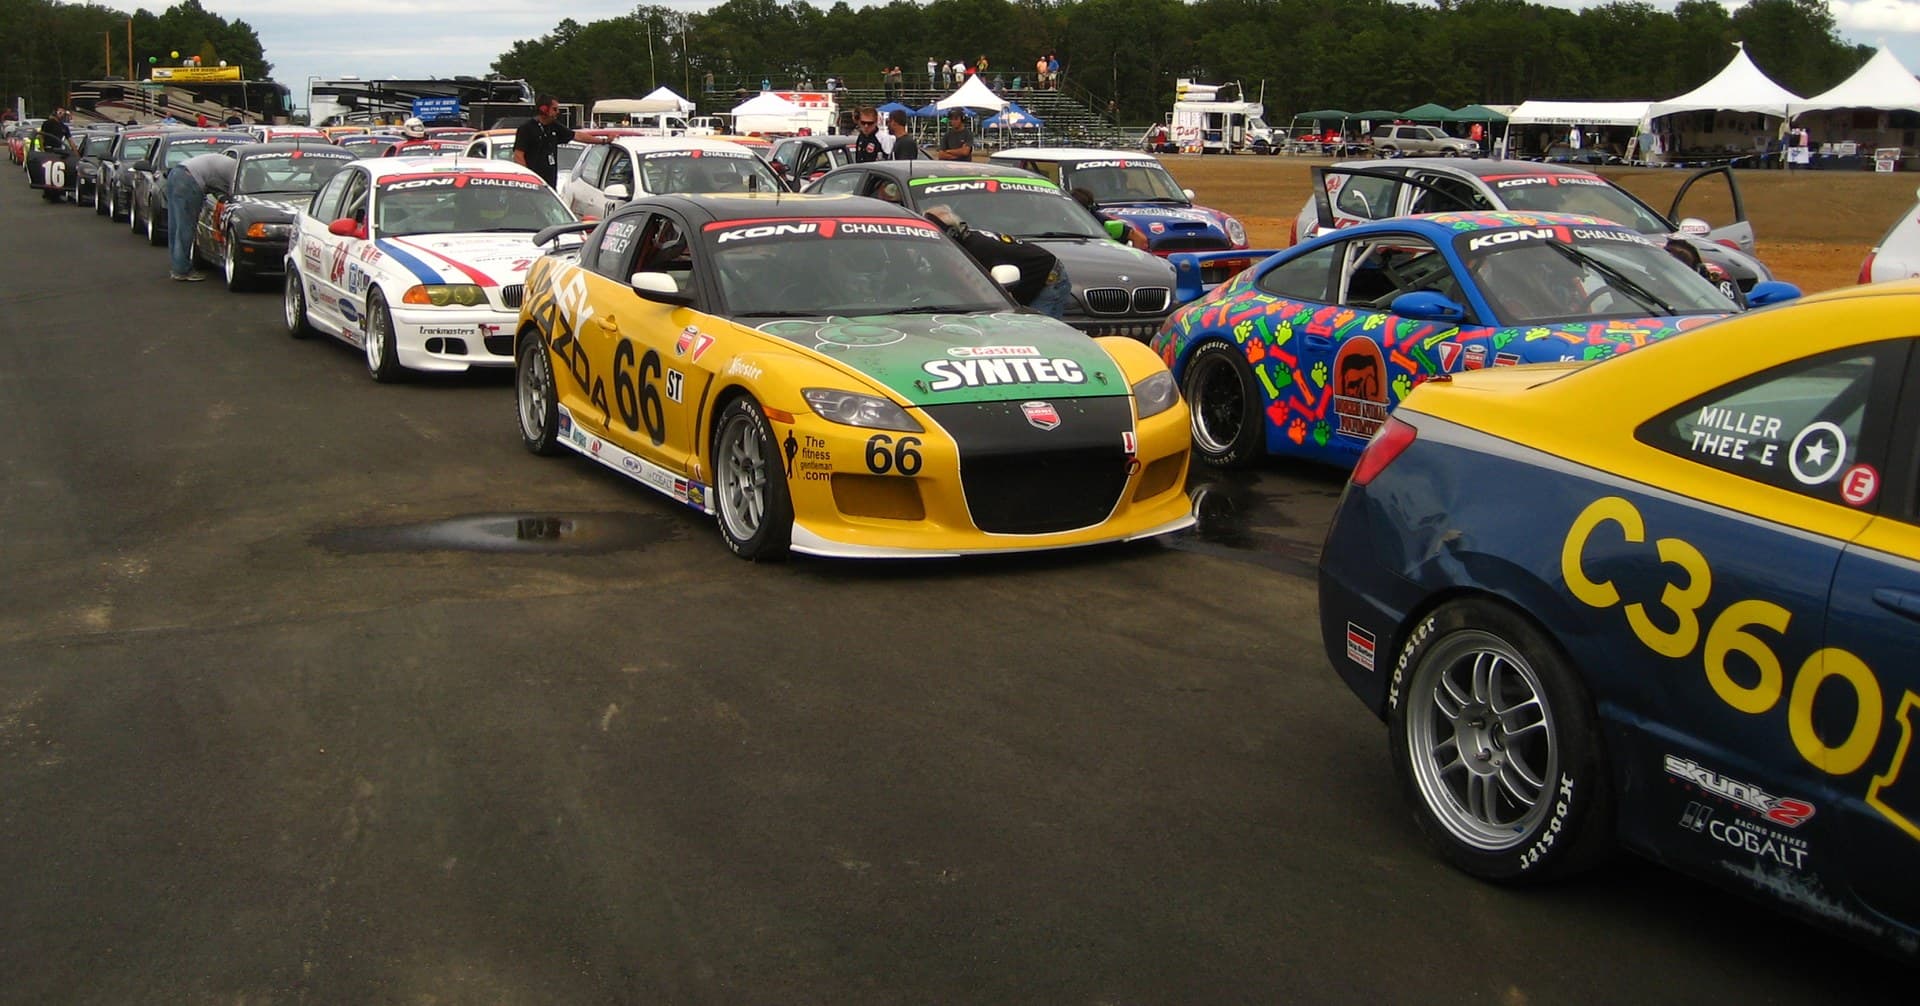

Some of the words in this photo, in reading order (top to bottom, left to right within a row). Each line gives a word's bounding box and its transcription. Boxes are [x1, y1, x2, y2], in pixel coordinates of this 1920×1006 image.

[244, 151, 292, 161] KONI
[303, 151, 353, 160] CHALLENGE
[645, 151, 692, 160] KONI
[702, 151, 752, 159] CHALLENGE
[1075, 161, 1121, 170] KONI
[41, 160, 66, 188] 16
[387, 178, 455, 191] KONI
[470, 177, 540, 191] CHALLENGE
[1497, 177, 1547, 188] KONI
[924, 181, 987, 194] KONI
[1000, 182, 1061, 196] CHALLENGE
[717, 223, 817, 244] KONI
[841, 223, 941, 240] CHALLENGE
[1469, 228, 1554, 251] KONI
[1574, 228, 1656, 247] CHALLENGE
[419, 325, 475, 335] trackmasters
[971, 346, 1034, 355] Castrol
[922, 357, 1087, 392] SYNTEC
[613, 338, 666, 446] 66
[668, 370, 683, 402] ST
[1696, 406, 1783, 440] MILLER
[805, 435, 825, 449] The
[1690, 430, 1750, 461] THEE
[802, 447, 831, 461] fitness
[865, 433, 923, 476] 66
[800, 461, 833, 471] gentleman
[803, 471, 830, 481] .com
[1846, 470, 1872, 498] E
[1388, 617, 1435, 710] Hoosier
[1520, 772, 1575, 870] Hoosier
[1734, 818, 1768, 837] RACING
[1770, 831, 1808, 849] BRAKES
[1709, 820, 1809, 870] COBALT
